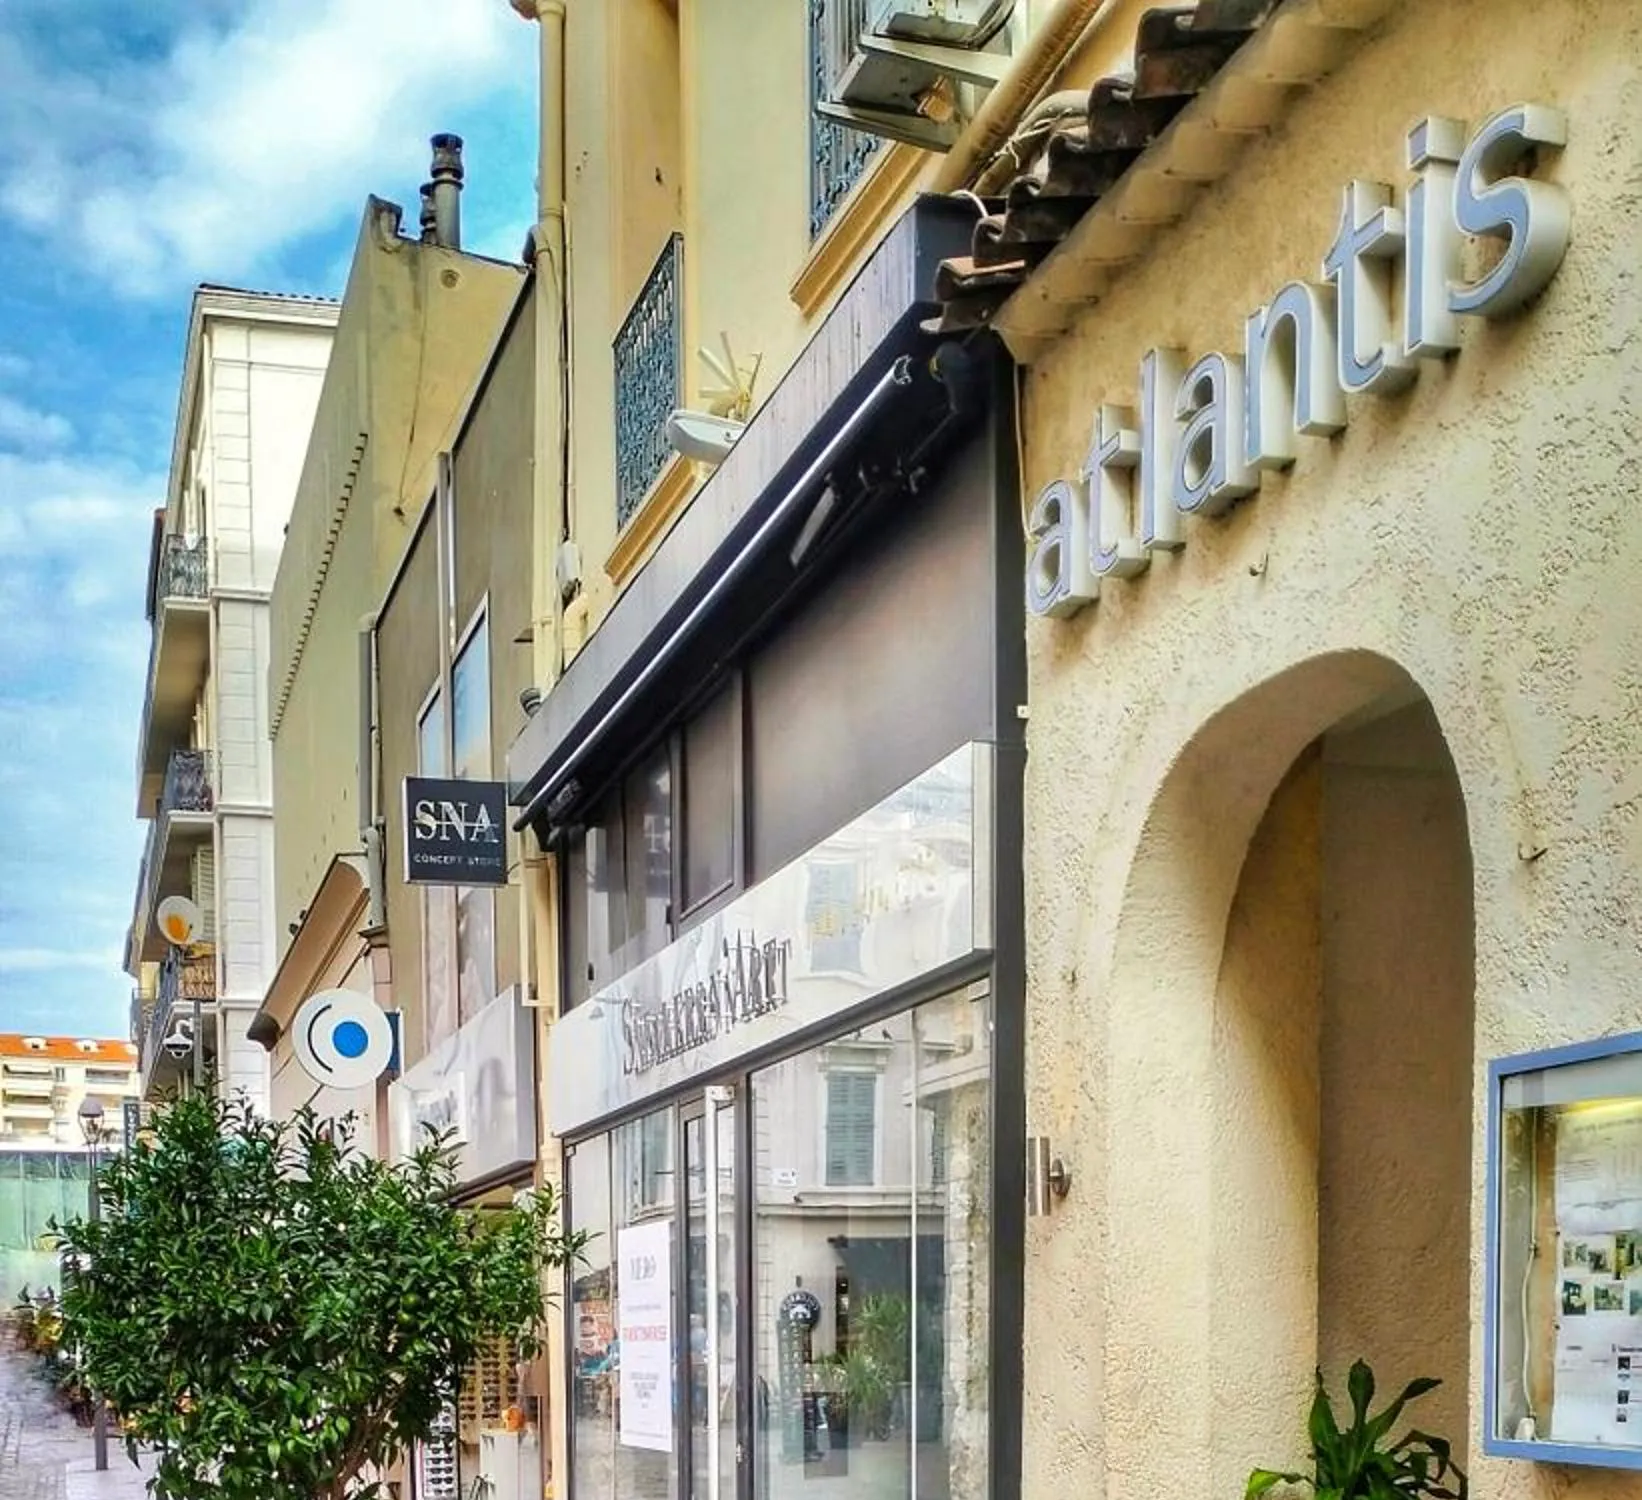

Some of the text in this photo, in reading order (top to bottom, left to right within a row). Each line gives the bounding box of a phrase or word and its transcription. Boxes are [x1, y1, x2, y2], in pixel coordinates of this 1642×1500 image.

[1027, 103, 1569, 618] atlantis
[414, 799, 499, 843] SNA
[414, 853, 462, 865] CONCEPT
